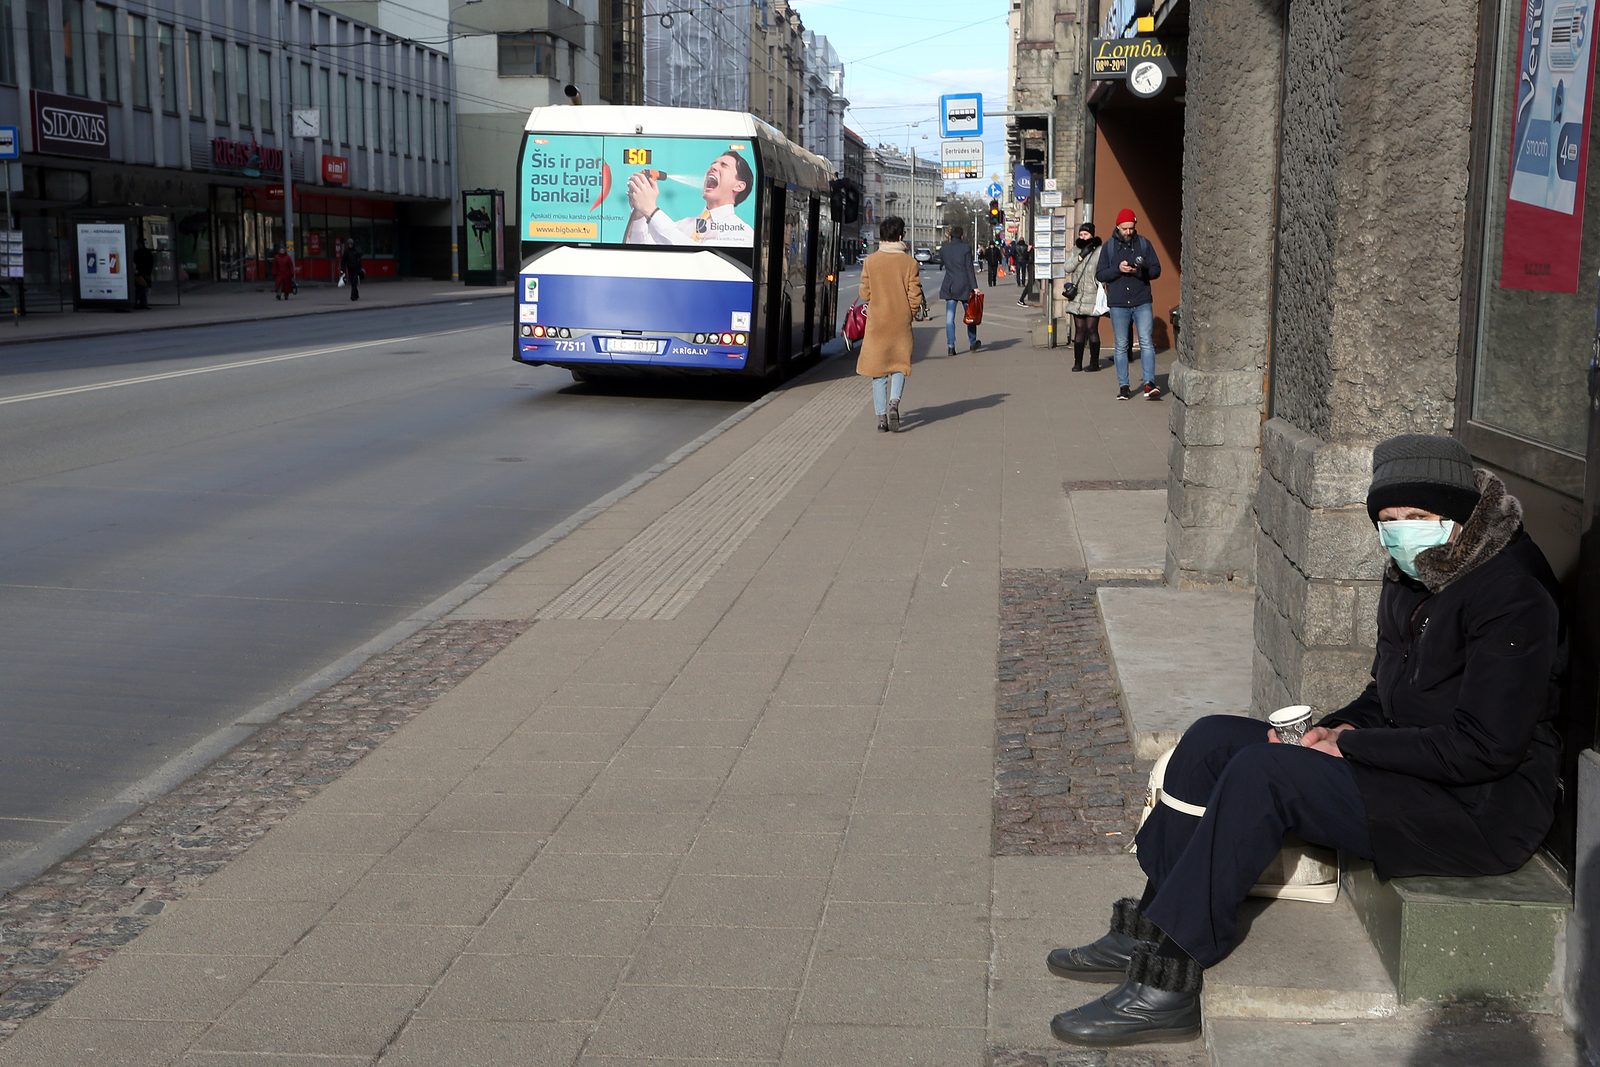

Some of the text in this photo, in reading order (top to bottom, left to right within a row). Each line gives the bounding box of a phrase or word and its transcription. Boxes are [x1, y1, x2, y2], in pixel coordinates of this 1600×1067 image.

[42, 107, 106, 145] SIDONAS
[1526, 137, 1549, 157] smooth
[1560, 135, 1568, 165] 4
[531, 149, 602, 172] Šis ir par
[628, 148, 647, 164] 50
[531, 171, 603, 186] asu tavai
[531, 188, 590, 203] bankai!
[710, 222, 745, 232] Bigbank
[555, 341, 586, 351] 77511
